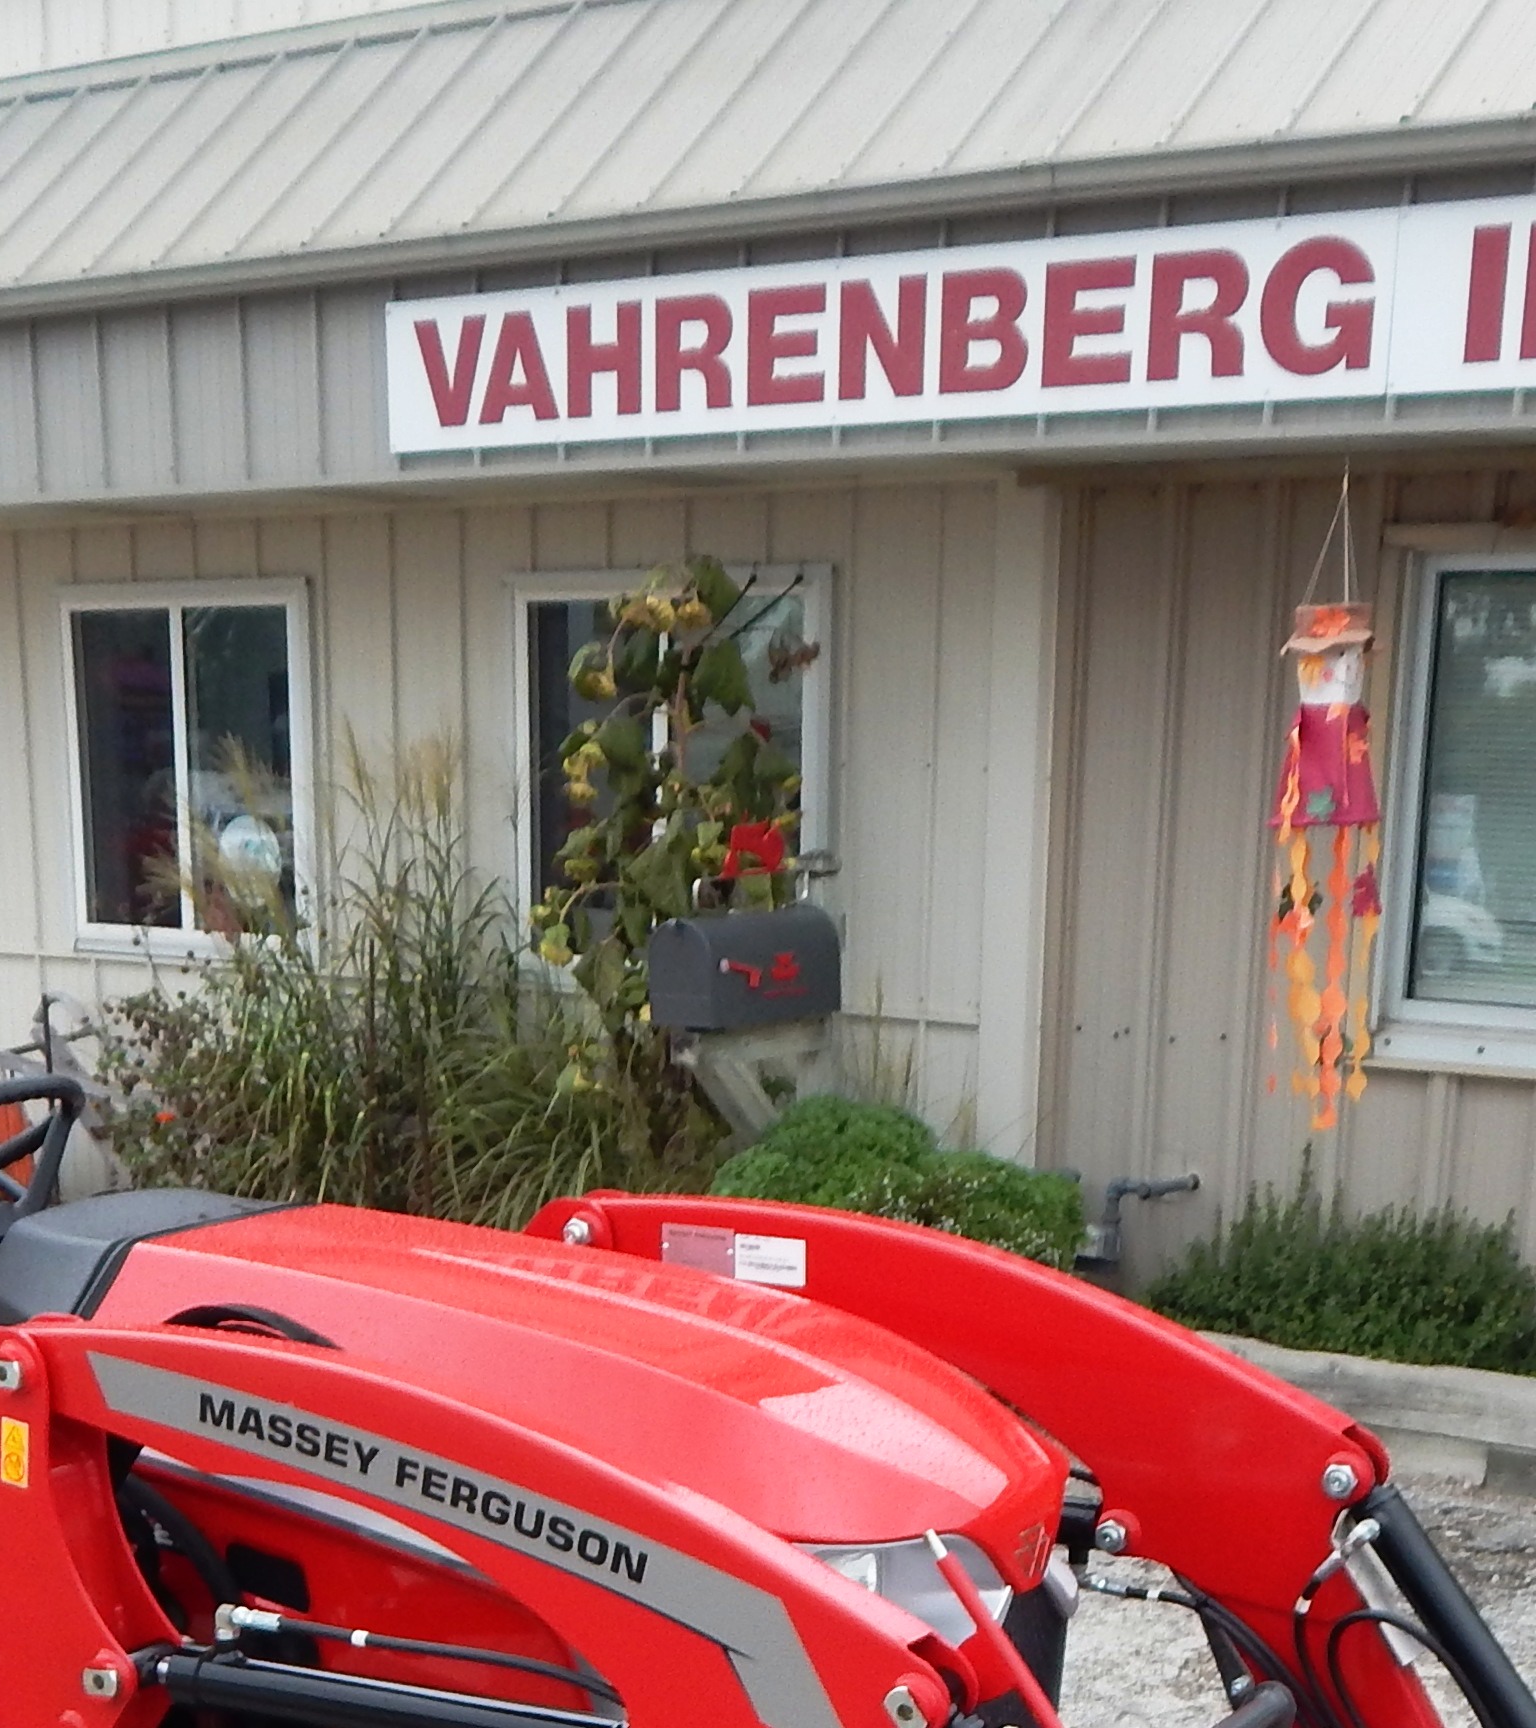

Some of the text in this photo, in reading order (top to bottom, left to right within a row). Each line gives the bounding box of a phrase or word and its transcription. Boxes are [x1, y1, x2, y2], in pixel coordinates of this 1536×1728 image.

[415, 238, 1375, 429] VAHRENBERG
[199, 1393, 648, 1584] MASSEY FERGUSON
